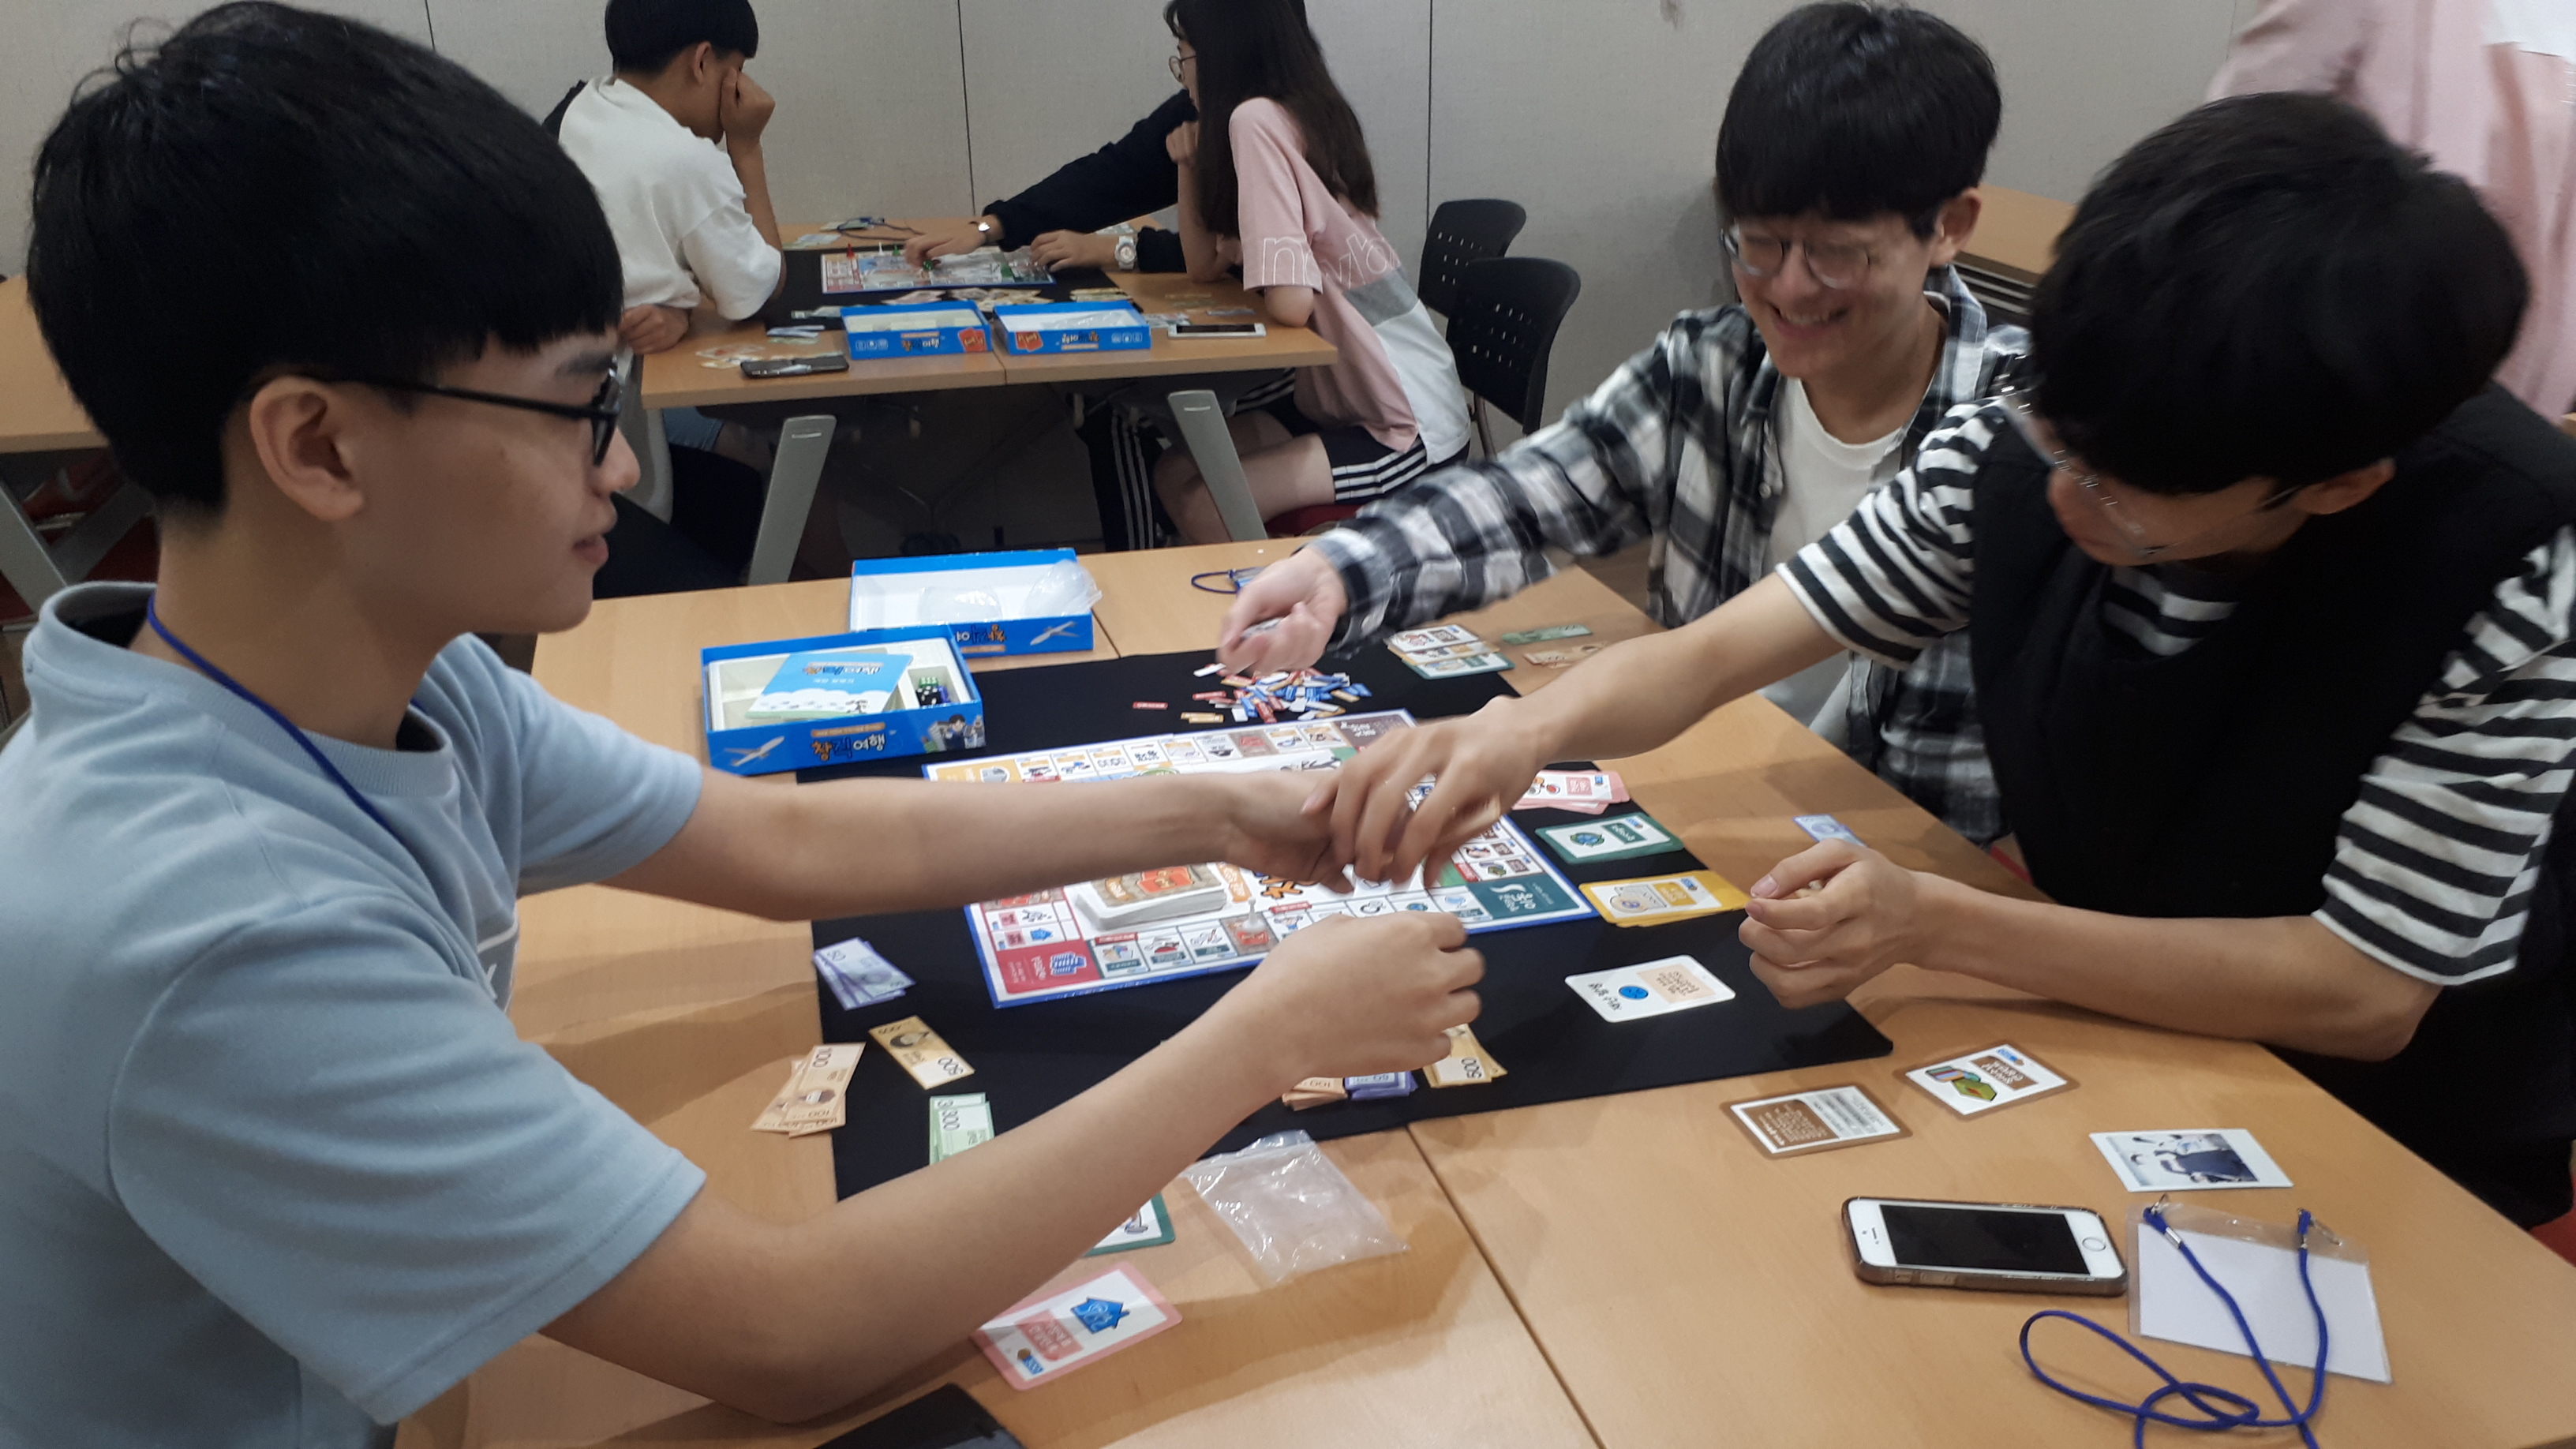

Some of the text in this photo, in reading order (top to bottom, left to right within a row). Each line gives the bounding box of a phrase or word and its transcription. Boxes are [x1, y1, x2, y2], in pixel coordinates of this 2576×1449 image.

[956, 623, 1007, 642] 창직여
[812, 1047, 832, 1067] 100
[938, 1058, 964, 1076] 500
[1461, 1057, 1481, 1079] 500
